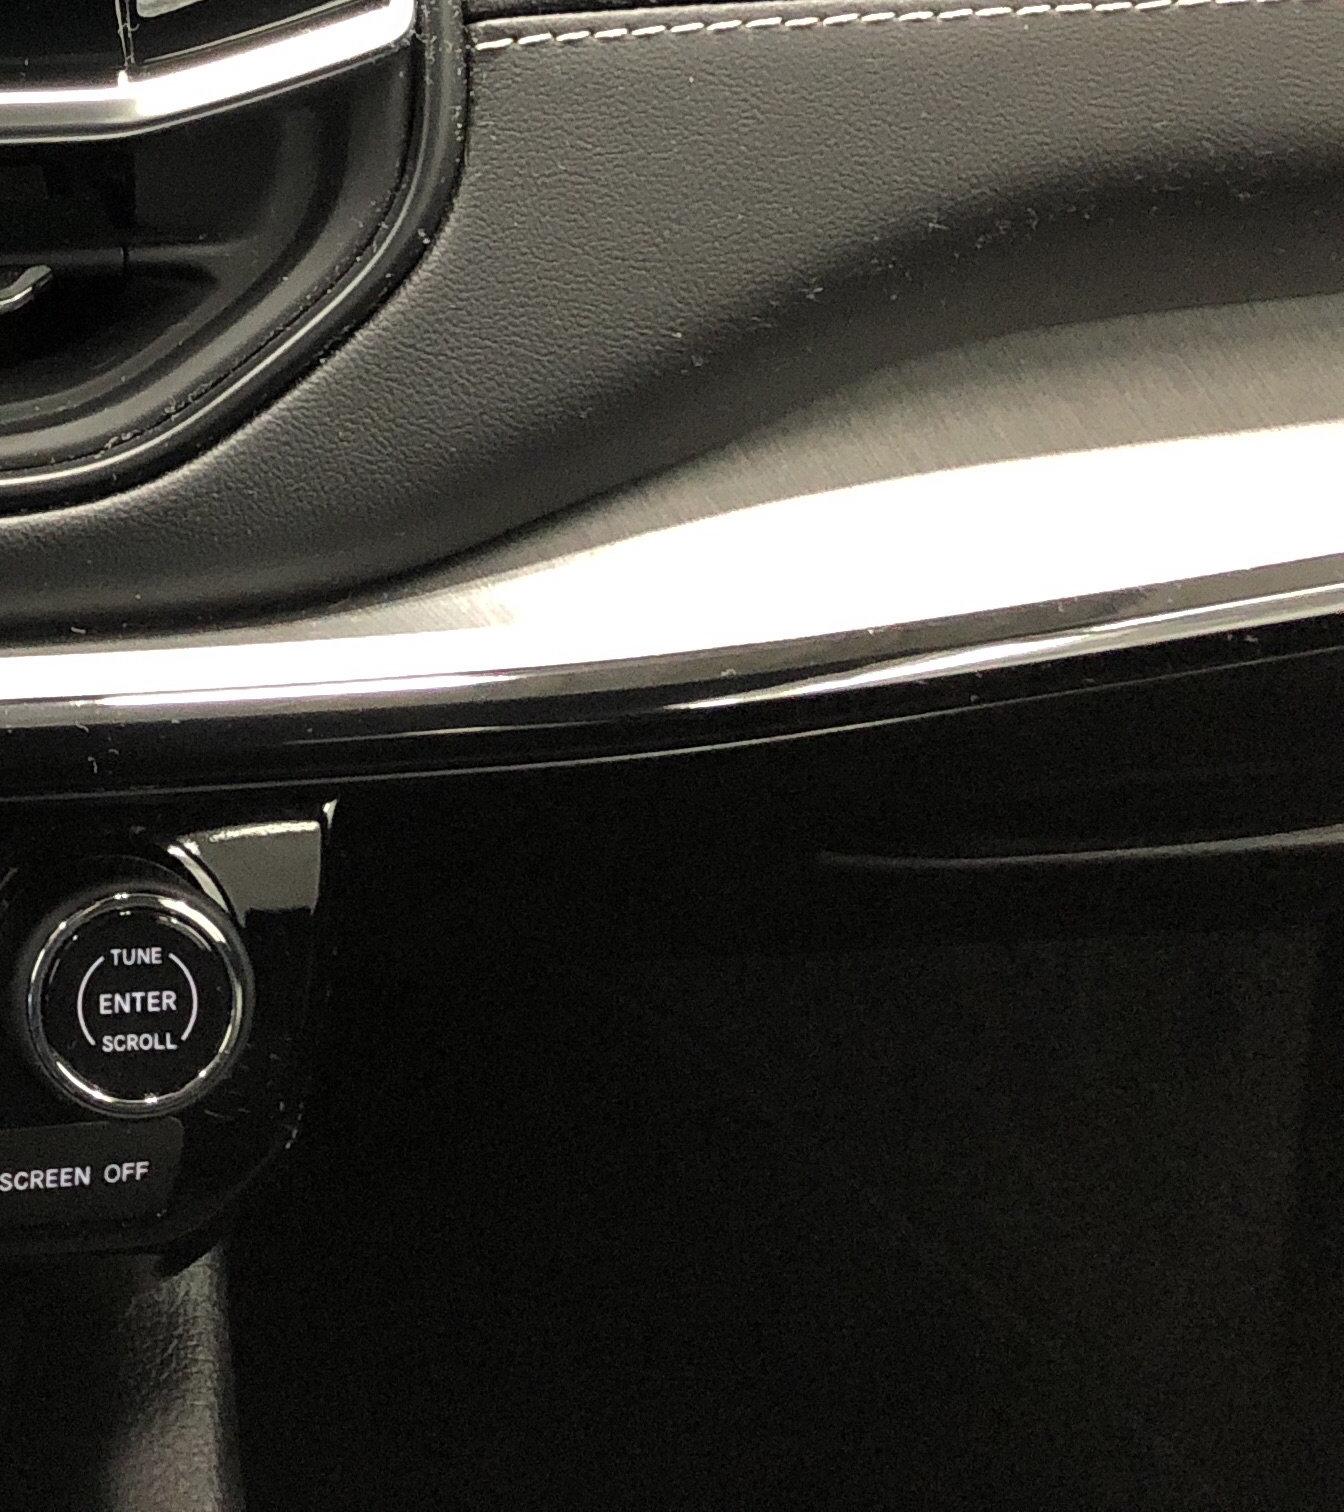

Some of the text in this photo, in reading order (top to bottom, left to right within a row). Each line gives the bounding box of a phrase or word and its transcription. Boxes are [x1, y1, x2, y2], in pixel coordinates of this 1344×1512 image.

[110, 946, 163, 967] TUNE
[98, 990, 178, 1015] ENTER
[101, 1032, 178, 1053] SCROLL
[104, 1160, 150, 1185] OFF
